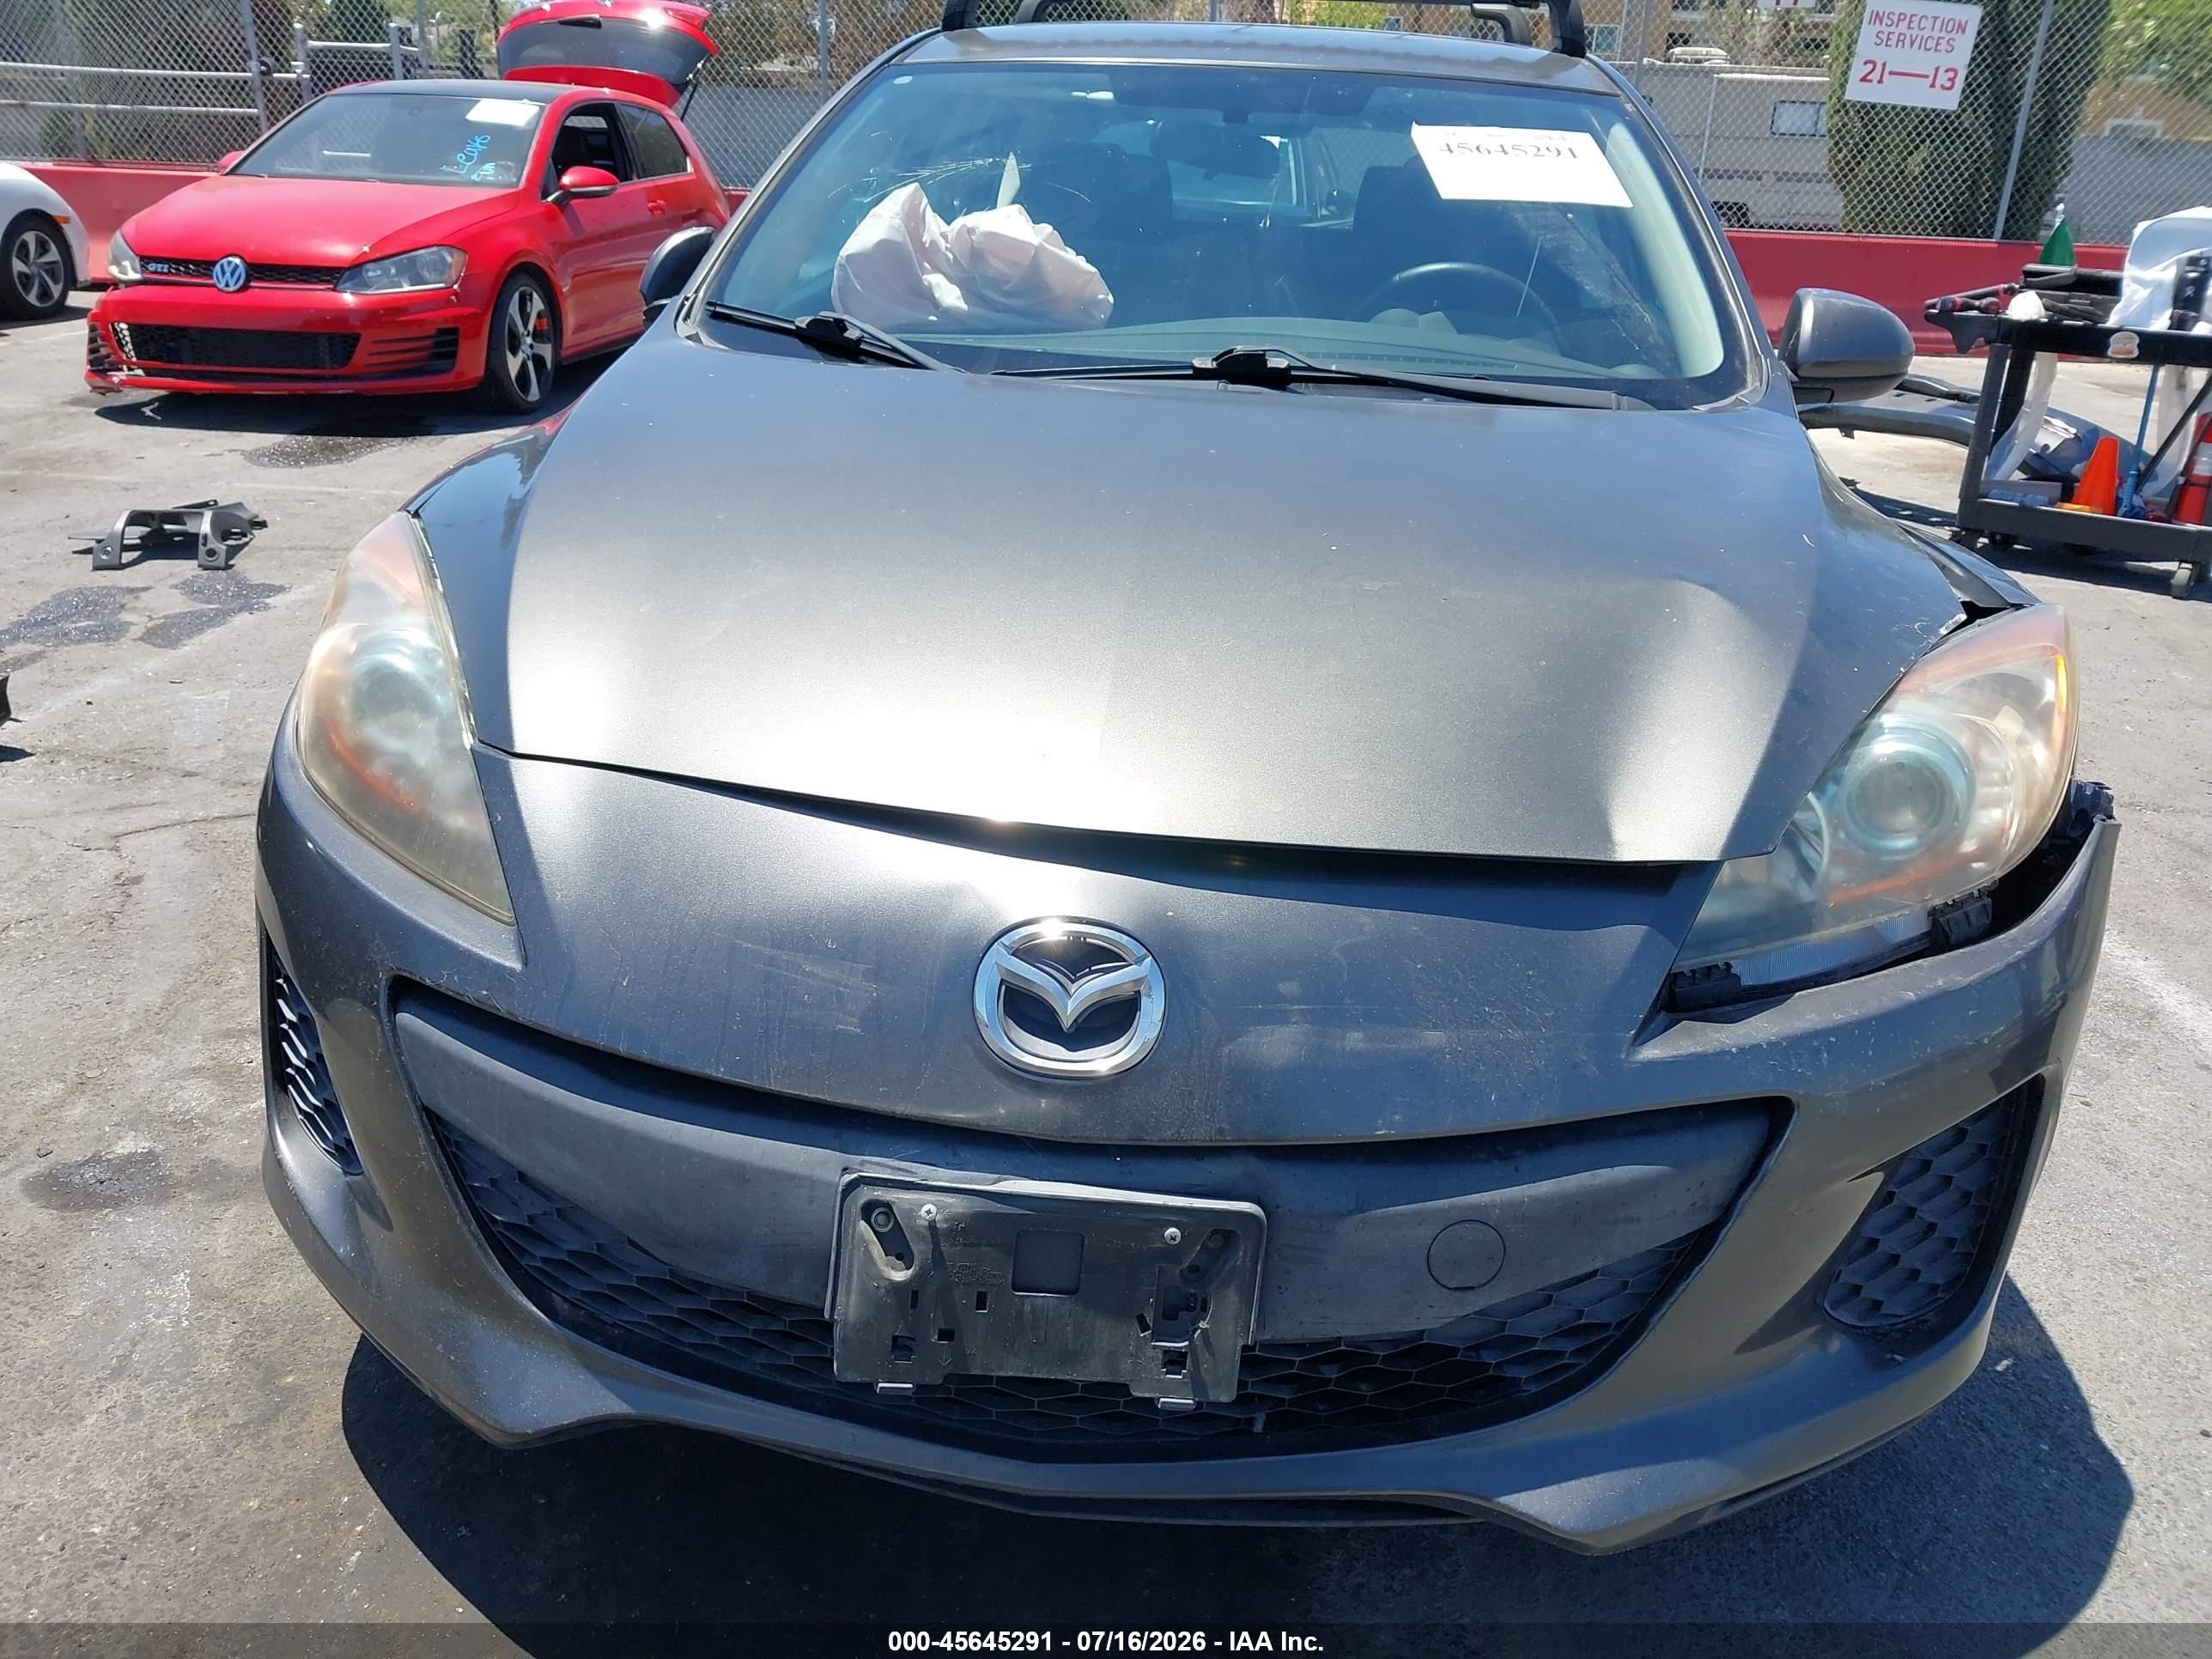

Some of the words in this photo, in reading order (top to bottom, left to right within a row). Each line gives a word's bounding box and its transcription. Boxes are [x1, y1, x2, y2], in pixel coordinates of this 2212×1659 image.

[1868, 9, 1968, 35] INSPECTION
[1874, 30, 1956, 53] SERVICES
[148, 263, 169, 272] GTI
